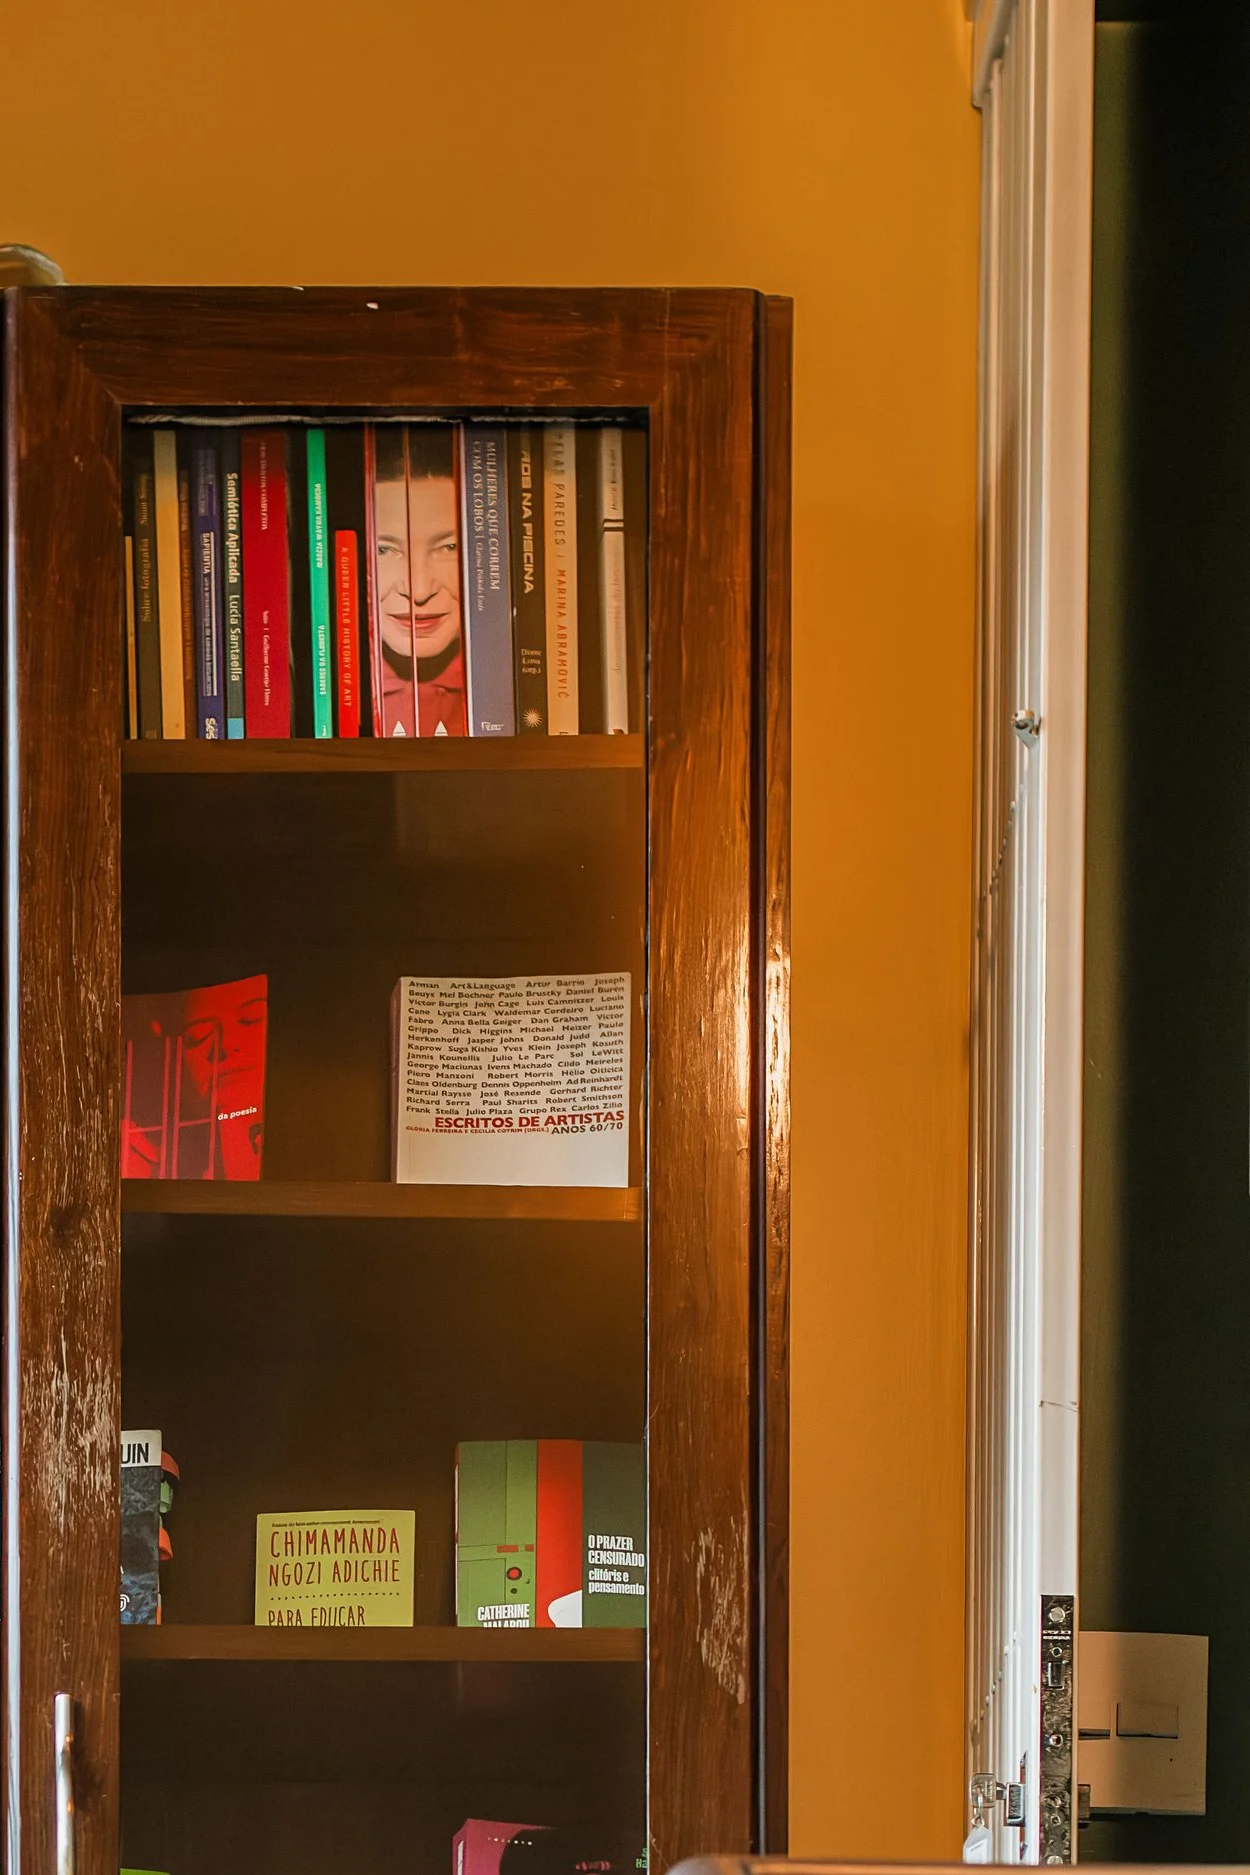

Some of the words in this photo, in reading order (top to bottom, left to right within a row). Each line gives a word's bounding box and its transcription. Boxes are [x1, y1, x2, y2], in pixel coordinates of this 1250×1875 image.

[472, 473, 484, 490] OS
[485, 442, 498, 506] MULHERES
[227, 473, 240, 530] Semiótica
[473, 493, 485, 532] LOBOS
[554, 483, 566, 546] PAREDES
[487, 509, 499, 535] QUE
[225, 533, 240, 583] Aplicada
[488, 538, 501, 590] CORREM
[556, 569, 567, 617] MARINA
[230, 627, 242, 681] Santaella
[557, 624, 570, 699] ABRAMOVIĆ
[230, 1106, 257, 1118] poesia
[406, 1106, 430, 1114] Frank
[466, 1108, 486, 1116] Julio
[519, 1106, 547, 1115] Grupo
[550, 1105, 566, 1113] Rex
[571, 1104, 599, 1112] Carlos
[603, 1101, 623, 1110] Zilio
[435, 1117, 514, 1128] ESCRITOS
[518, 1116, 540, 1127] DE
[544, 1110, 625, 1126] ARTISTAS
[551, 1125, 585, 1134] ANOS
[590, 1122, 623, 1132] 60/70
[270, 1528, 400, 1558] CHIMAMANDA
[588, 1535, 595, 1548] O
[597, 1536, 633, 1551] PRAZER
[588, 1551, 645, 1567] CENSURADO
[268, 1562, 322, 1586] NGOZI
[332, 1559, 400, 1584] ADICHIE
[588, 1569, 621, 1582] clitóris
[622, 1571, 629, 1582] e
[588, 1582, 645, 1595] pensamento
[268, 1608, 302, 1626] PARA
[311, 1606, 366, 1626] EDUCAR
[477, 1604, 530, 1621] CATHERINE
